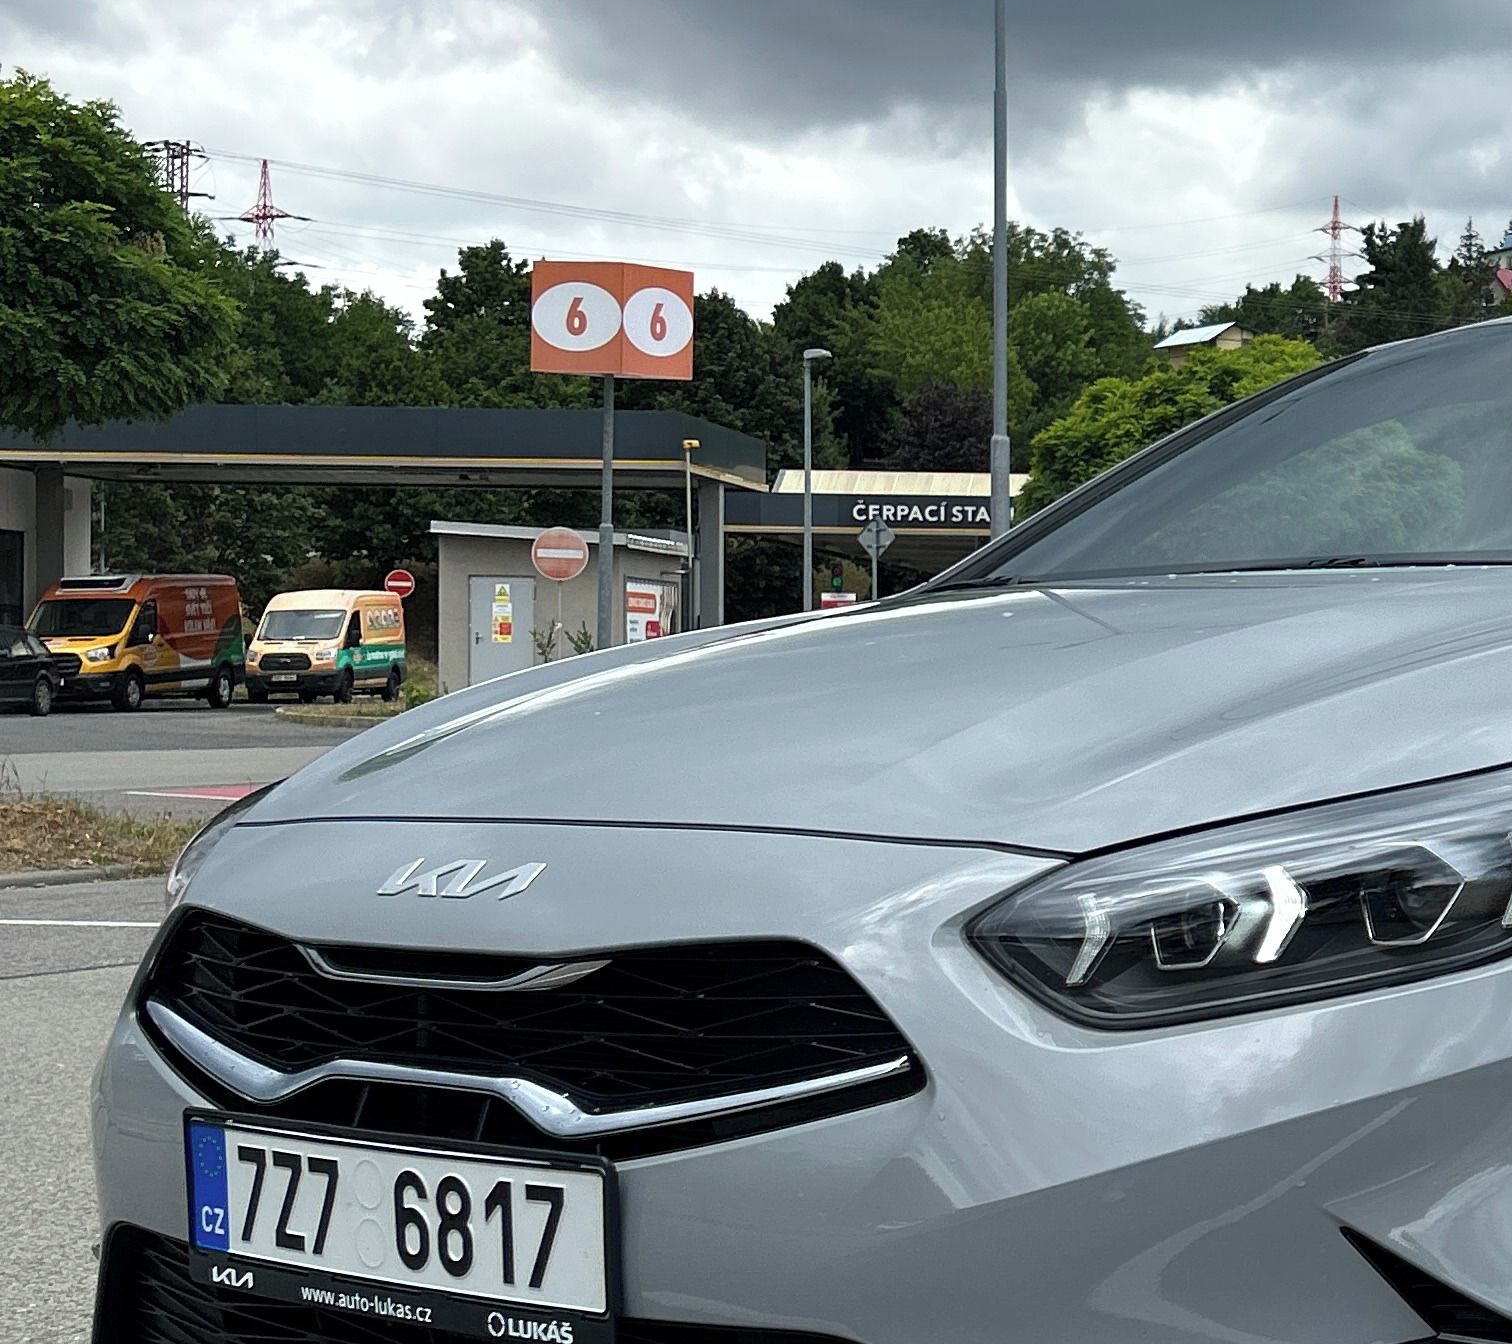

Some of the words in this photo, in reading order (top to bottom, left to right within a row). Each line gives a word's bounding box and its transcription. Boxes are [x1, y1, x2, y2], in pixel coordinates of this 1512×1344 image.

[566, 297, 587, 336] 6
[650, 303, 667, 341] 6
[852, 499, 947, 522] ČERPACÍ
[376, 856, 548, 901] KIA
[200, 1204, 226, 1236] CZ
[236, 1145, 340, 1256] 7Z7
[393, 1168, 566, 1289] 6817
[212, 1265, 254, 1290] KIA
[300, 1285, 433, 1324] www.auto-lukas.cz
